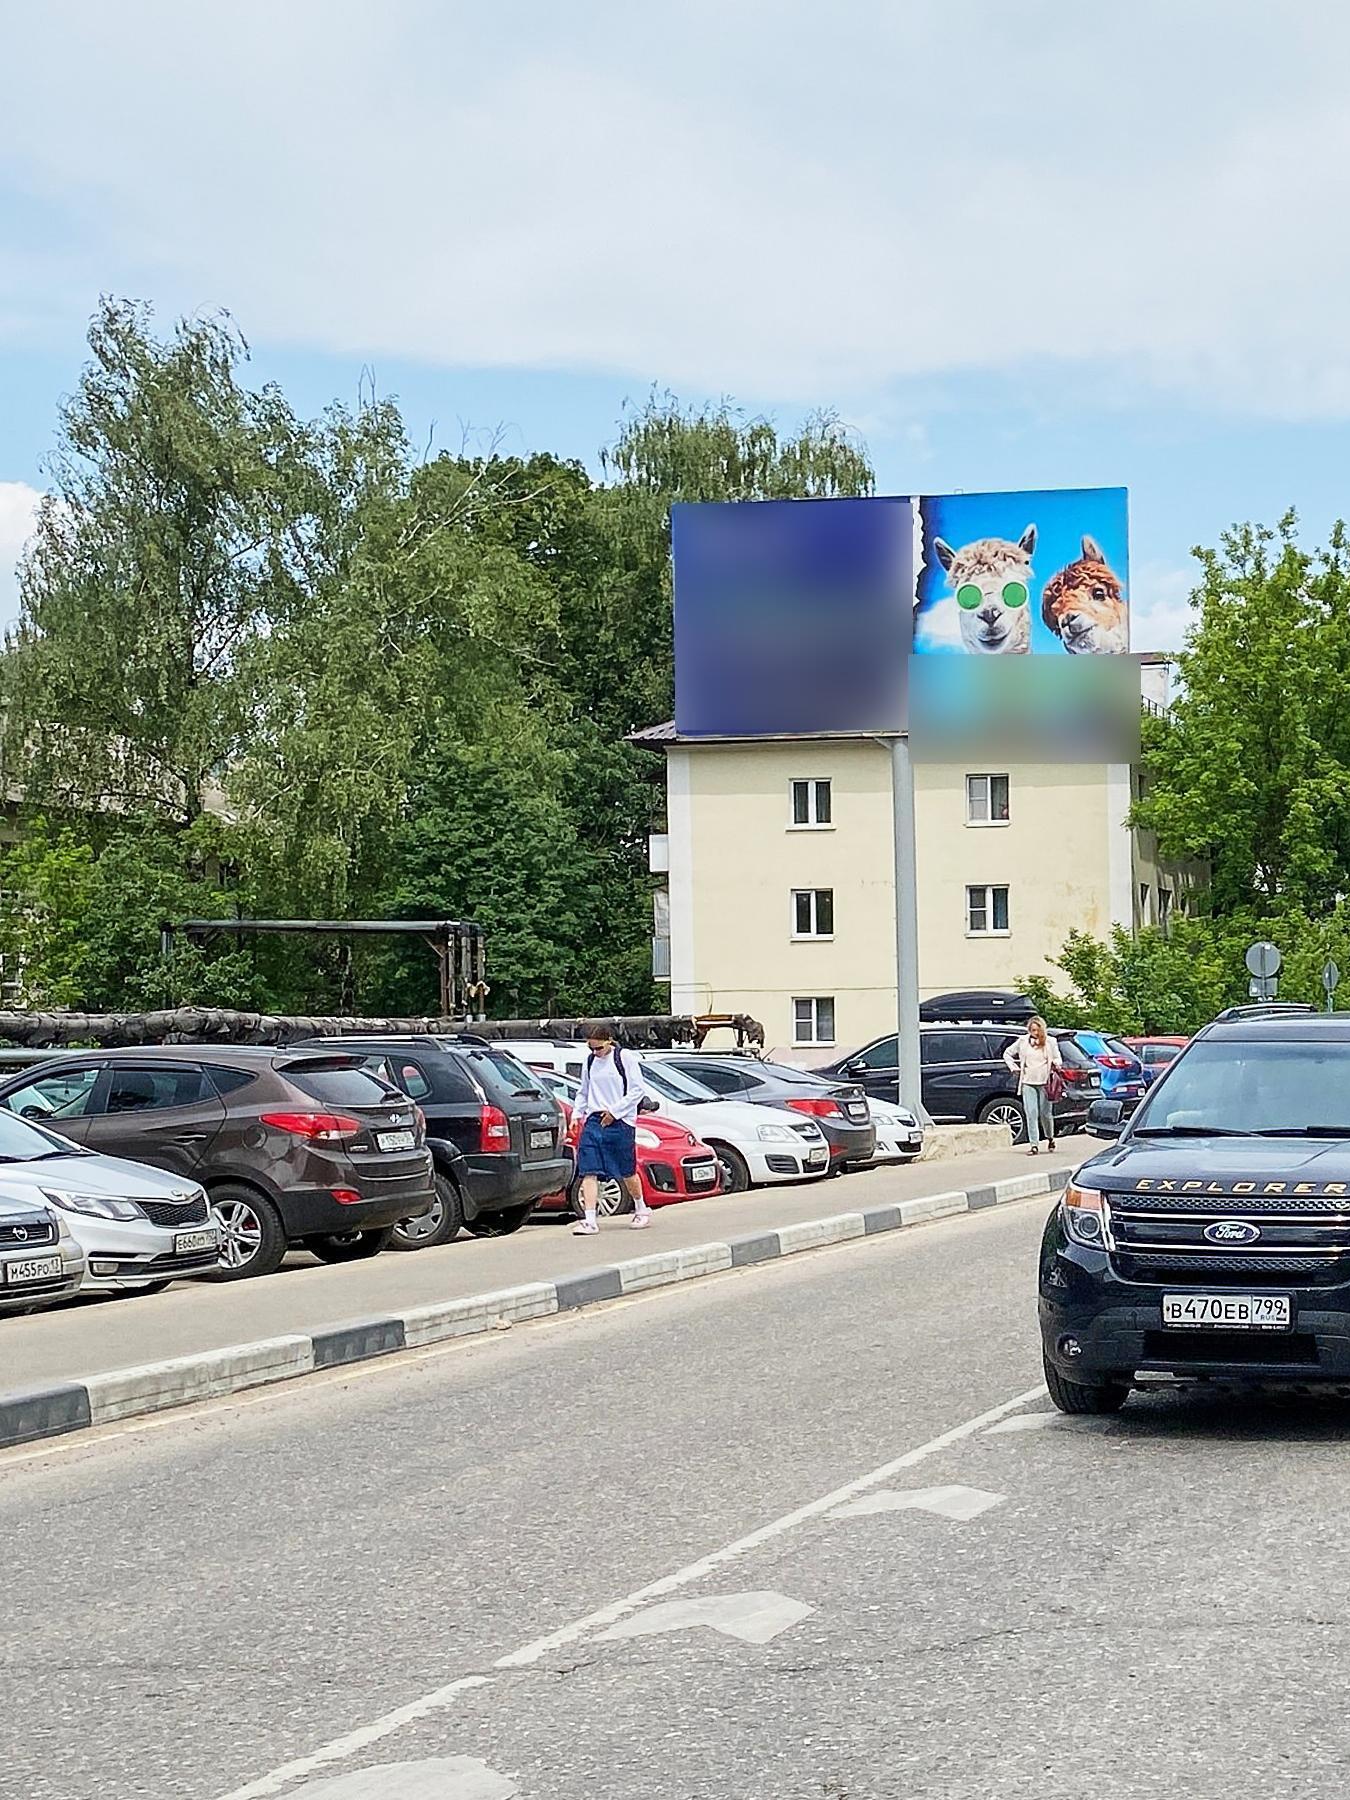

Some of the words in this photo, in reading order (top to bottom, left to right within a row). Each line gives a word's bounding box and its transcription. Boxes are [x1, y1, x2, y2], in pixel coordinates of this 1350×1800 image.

[1135, 1178, 1348, 1194] EXPLORER
[1214, 1223, 1246, 1240] Ford
[1253, 1299, 1284, 1315] 799
